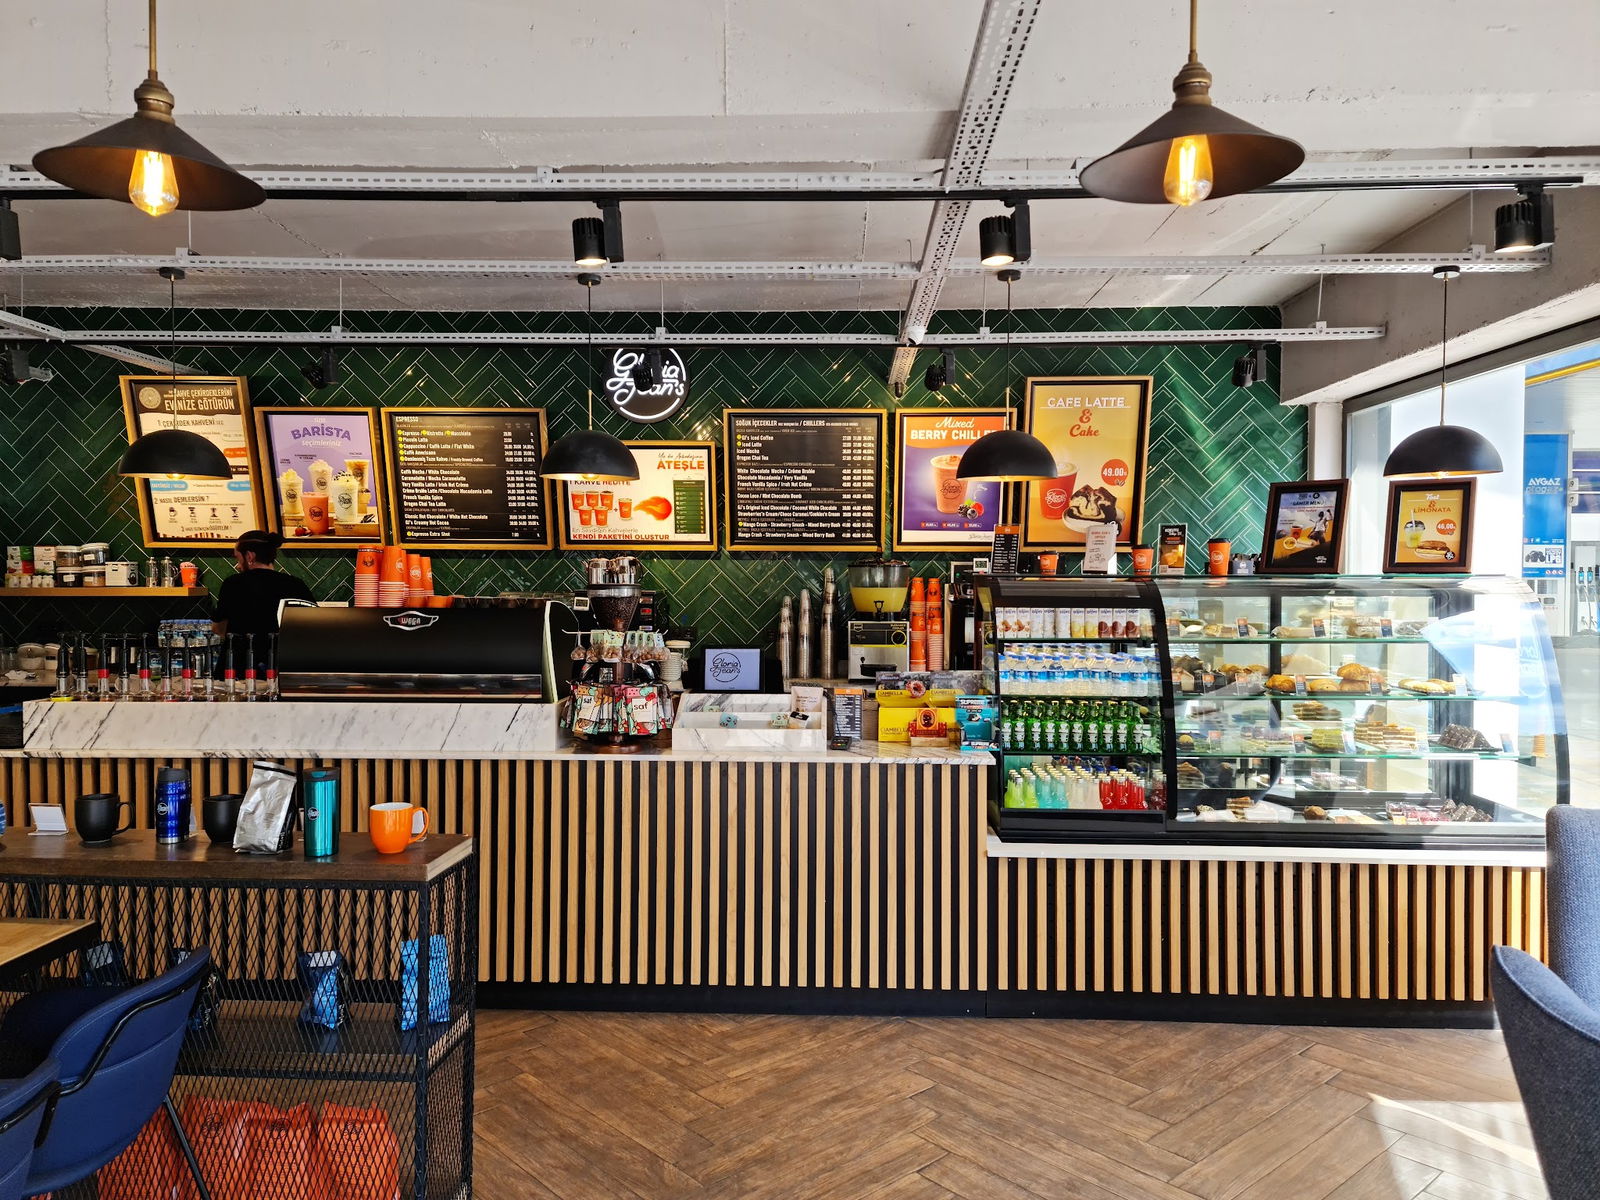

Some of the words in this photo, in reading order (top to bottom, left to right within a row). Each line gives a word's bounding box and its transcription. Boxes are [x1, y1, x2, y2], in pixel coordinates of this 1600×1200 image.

[198, 398, 235, 410] GÖTÜRÜN
[1047, 398, 1081, 407] CAFE
[1086, 397, 1125, 407] LATTE
[1079, 408, 1092, 424] &
[935, 417, 975, 428] Mixed
[290, 423, 352, 440] BARİSTA
[910, 430, 948, 440] BERRY
[1069, 424, 1100, 437] Cake
[657, 460, 705, 471] ATEŞLE
[1528, 478, 1561, 486] AYGAZ
[710, 658, 738, 672] Gloria
